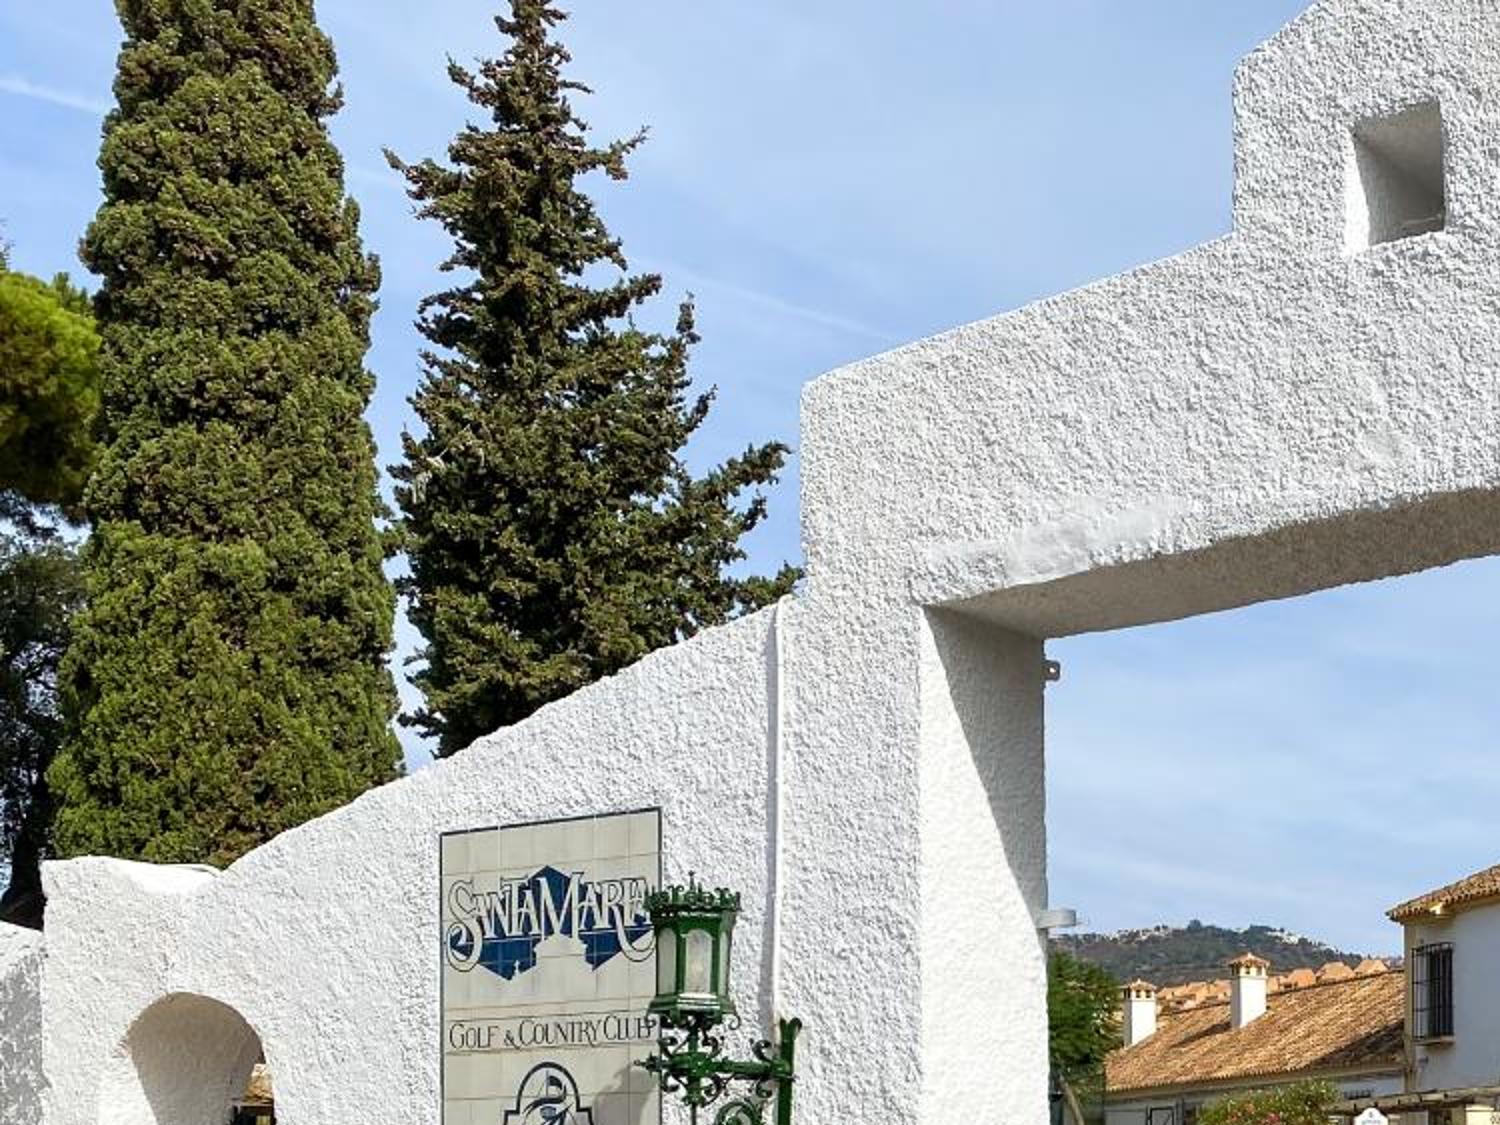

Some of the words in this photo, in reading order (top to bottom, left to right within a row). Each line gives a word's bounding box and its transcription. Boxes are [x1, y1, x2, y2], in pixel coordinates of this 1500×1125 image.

[447, 877, 541, 972] SANTA
[450, 1023, 498, 1049] GOLF
[503, 1029, 519, 1050] &
[518, 1018, 601, 1049] COUNTRY
[603, 1015, 652, 1041] CLUB
